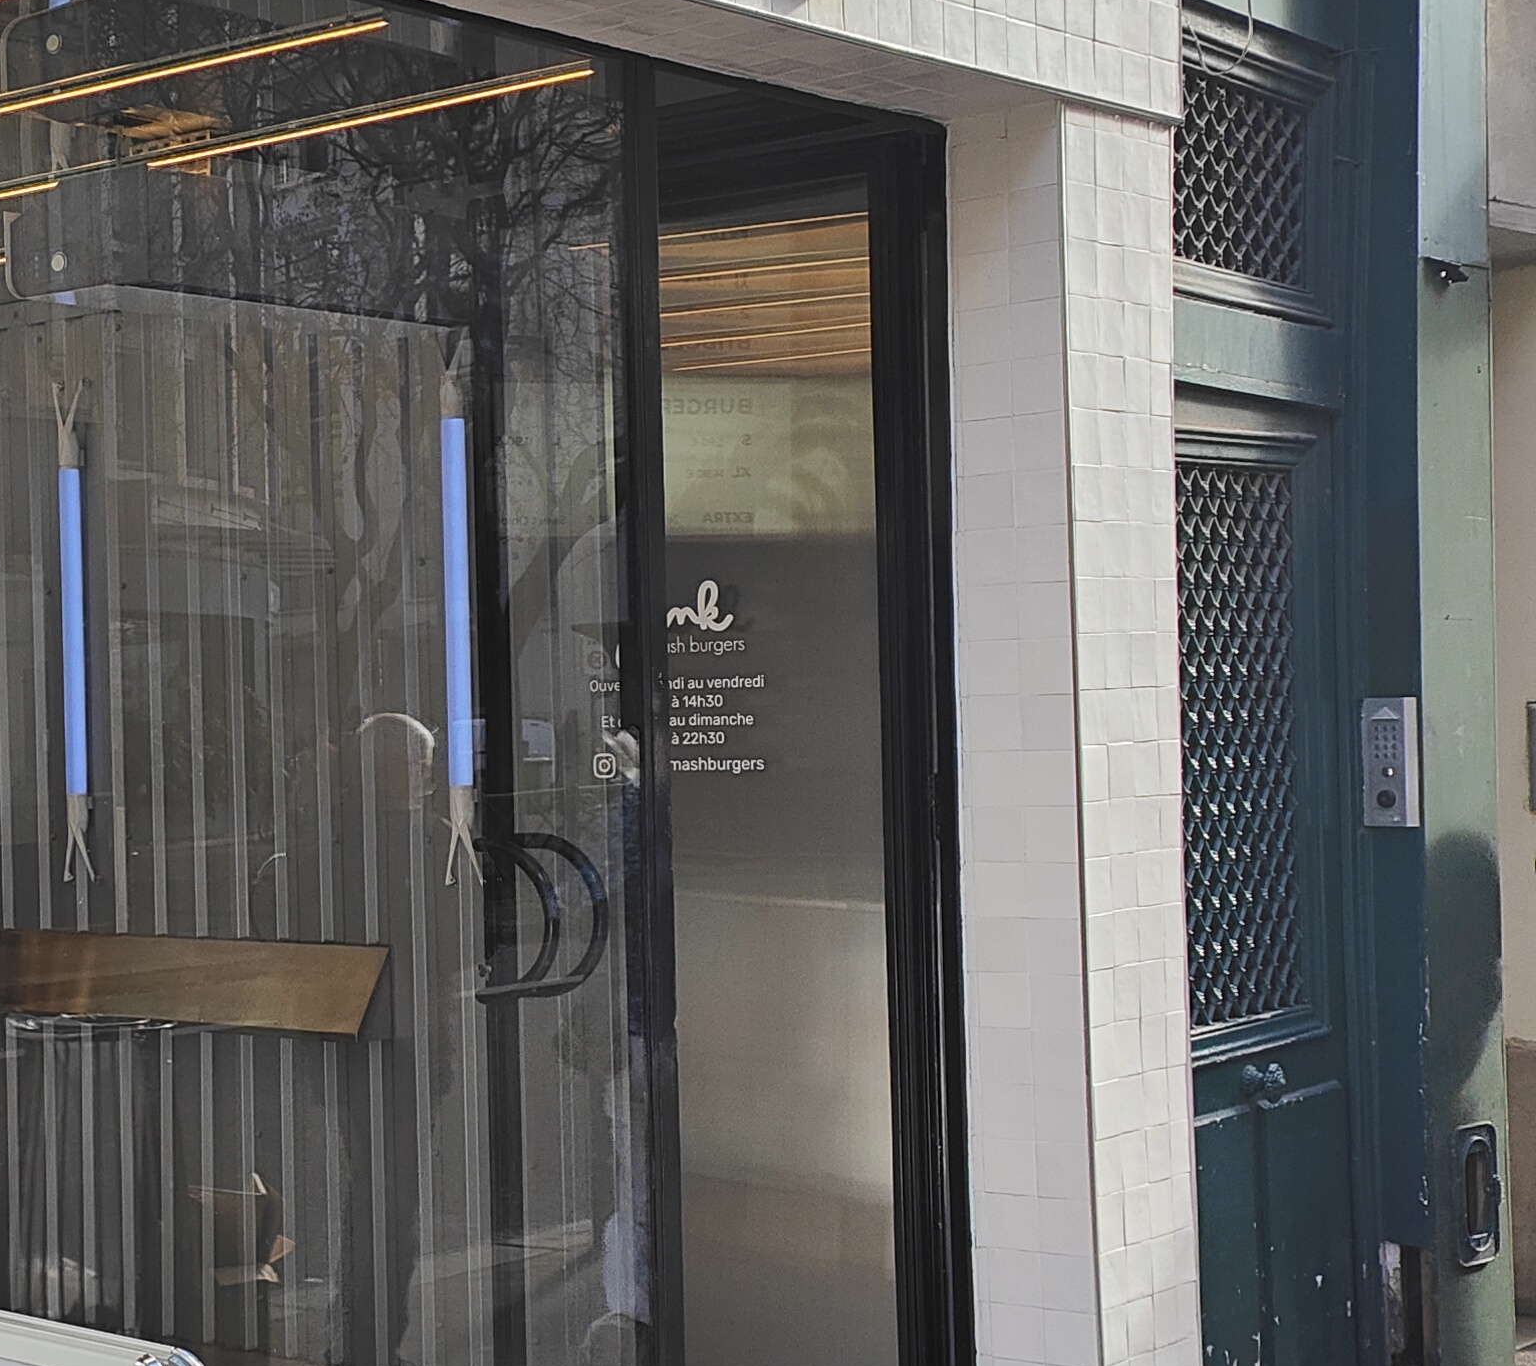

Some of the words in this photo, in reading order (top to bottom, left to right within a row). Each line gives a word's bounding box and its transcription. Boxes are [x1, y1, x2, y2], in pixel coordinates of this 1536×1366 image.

[667, 580, 734, 632] nk
[690, 636, 745, 655] burgers
[590, 680, 621, 693] Ouve
[688, 678, 703, 689] au
[706, 674, 764, 688] vendredi
[671, 695, 679, 708] à
[682, 694, 724, 708] 14h30
[601, 715, 615, 728] Et
[669, 714, 686, 726] au
[689, 712, 754, 726] dimanche
[671, 732, 679, 745] à
[682, 731, 725, 745] 22h30
[670, 756, 764, 774] mashburgers
